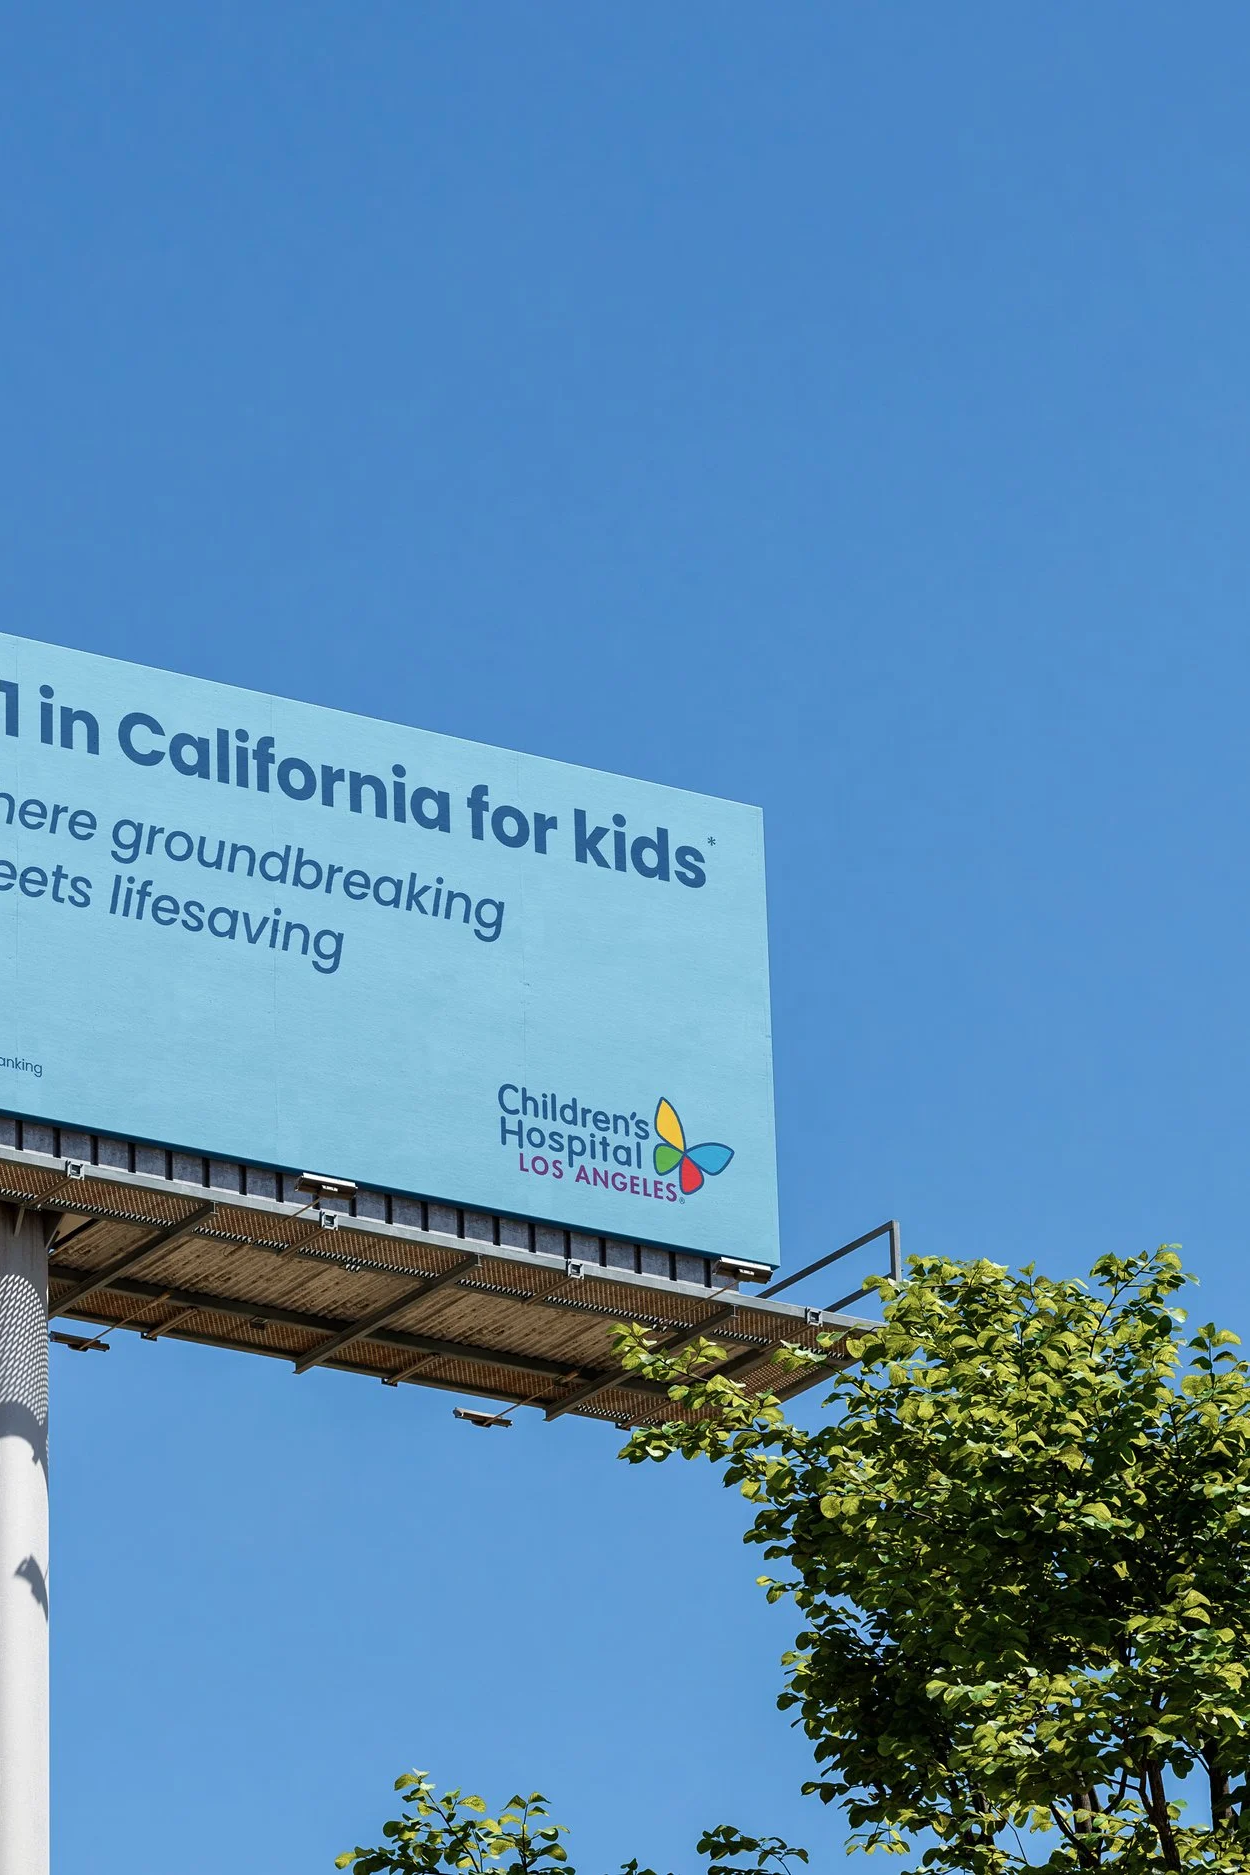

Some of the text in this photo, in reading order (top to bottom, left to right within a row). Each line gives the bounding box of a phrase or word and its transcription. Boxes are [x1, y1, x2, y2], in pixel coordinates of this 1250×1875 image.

[39, 685, 99, 756] in
[118, 711, 451, 834] California
[466, 784, 558, 855] for
[110, 818, 505, 943] groundbreaking
[109, 874, 344, 974] lifesaving
[498, 1083, 650, 1140] Children's
[500, 1115, 642, 1169] Hospital
[519, 1152, 564, 1180] LOS
